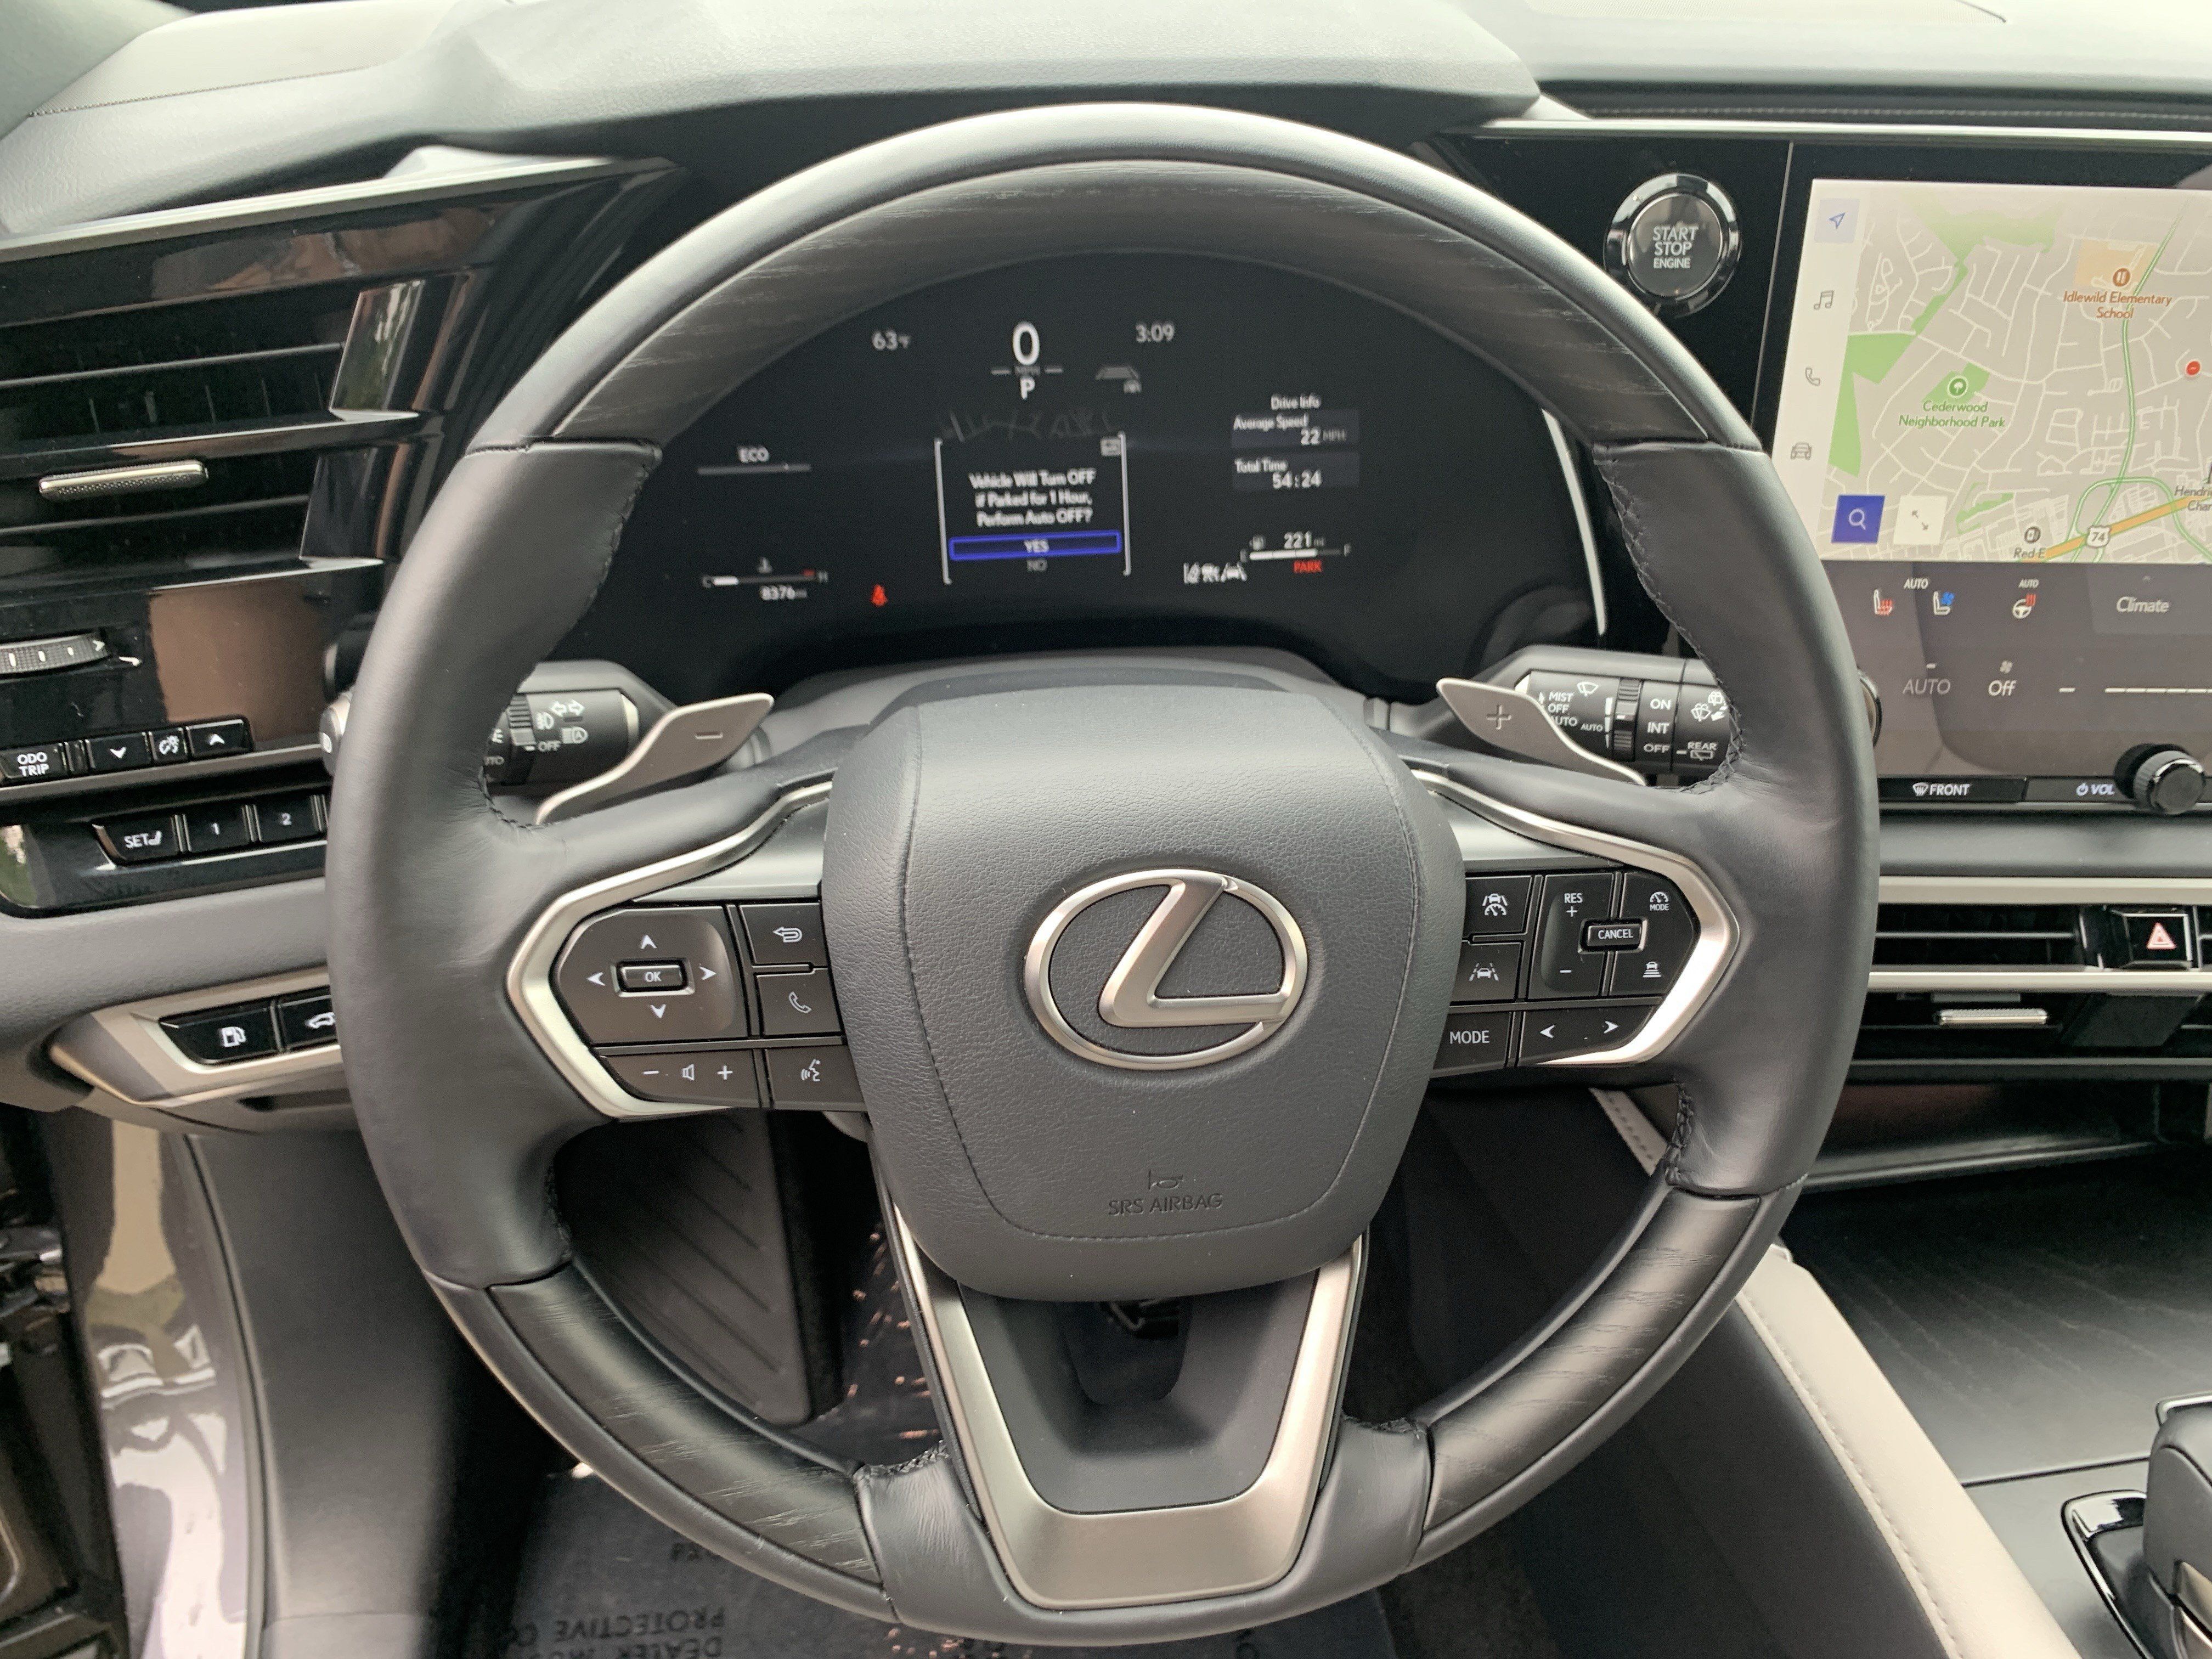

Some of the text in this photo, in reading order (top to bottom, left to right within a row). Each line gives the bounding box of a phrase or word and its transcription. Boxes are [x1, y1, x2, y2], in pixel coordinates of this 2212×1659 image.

[1652, 226, 1699, 241] START
[1654, 242, 1692, 256] STOP
[1654, 257, 1691, 269] ENGINE
[2063, 290, 2172, 307] Idlewild Elementary
[2097, 306, 2134, 319] School
[1136, 321, 1174, 342] 3:09
[1013, 321, 1040, 365] 0
[1020, 376, 1036, 399] P
[1271, 393, 1321, 410] Drive Info
[1923, 399, 1988, 412] Cederwood
[1234, 413, 1309, 432] Average Speed
[1899, 414, 2005, 429] Neighborhood Park
[1301, 427, 1321, 445] 22
[738, 447, 769, 463] ECO
[1235, 457, 1288, 473] Total Time
[968, 469, 1096, 488] Vehicle Will Turn OFF
[988, 490, 1028, 507] Parked
[1029, 490, 1047, 506] for
[1050, 489, 1057, 505] 1
[977, 507, 1093, 527] Perform Auto OFF?
[1284, 531, 1312, 549] 221
[2092, 531, 2106, 542] 74
[1024, 539, 1049, 553] YES
[2013, 547, 2035, 558] Red
[1026, 558, 1047, 572] NO
[1904, 578, 1929, 590] AUTO
[2019, 579, 2039, 589] AUTO
[2117, 596, 2170, 614] Climate
[1903, 679, 1951, 695] AUTO
[1988, 680, 2017, 697] Off
[1548, 691, 1575, 702] MIST
[1547, 703, 1570, 714] OFF
[1650, 698, 1671, 710] ON
[1580, 723, 1604, 732] AUTO
[1646, 722, 1670, 734] INT
[538, 741, 562, 752] OFF
[1643, 743, 1671, 754] OFF
[1687, 741, 1717, 751] REAR
[17, 752, 48, 765] ODO
[19, 763, 49, 777] TRIP
[1929, 783, 1971, 797] FRONT
[2091, 783, 2115, 795] VOL
[281, 812, 292, 826] 2
[211, 823, 219, 835] 1
[124, 834, 150, 848] SET
[1564, 892, 1583, 904] RES
[1649, 902, 1669, 912] MODE
[1598, 928, 1634, 940] CANCEL
[644, 970, 662, 983] OK
[1449, 1030, 1489, 1045] MODE
[1108, 1193, 1223, 1216] SRS AIRBAG
[555, 1606, 725, 1642] PROTECTIVE
